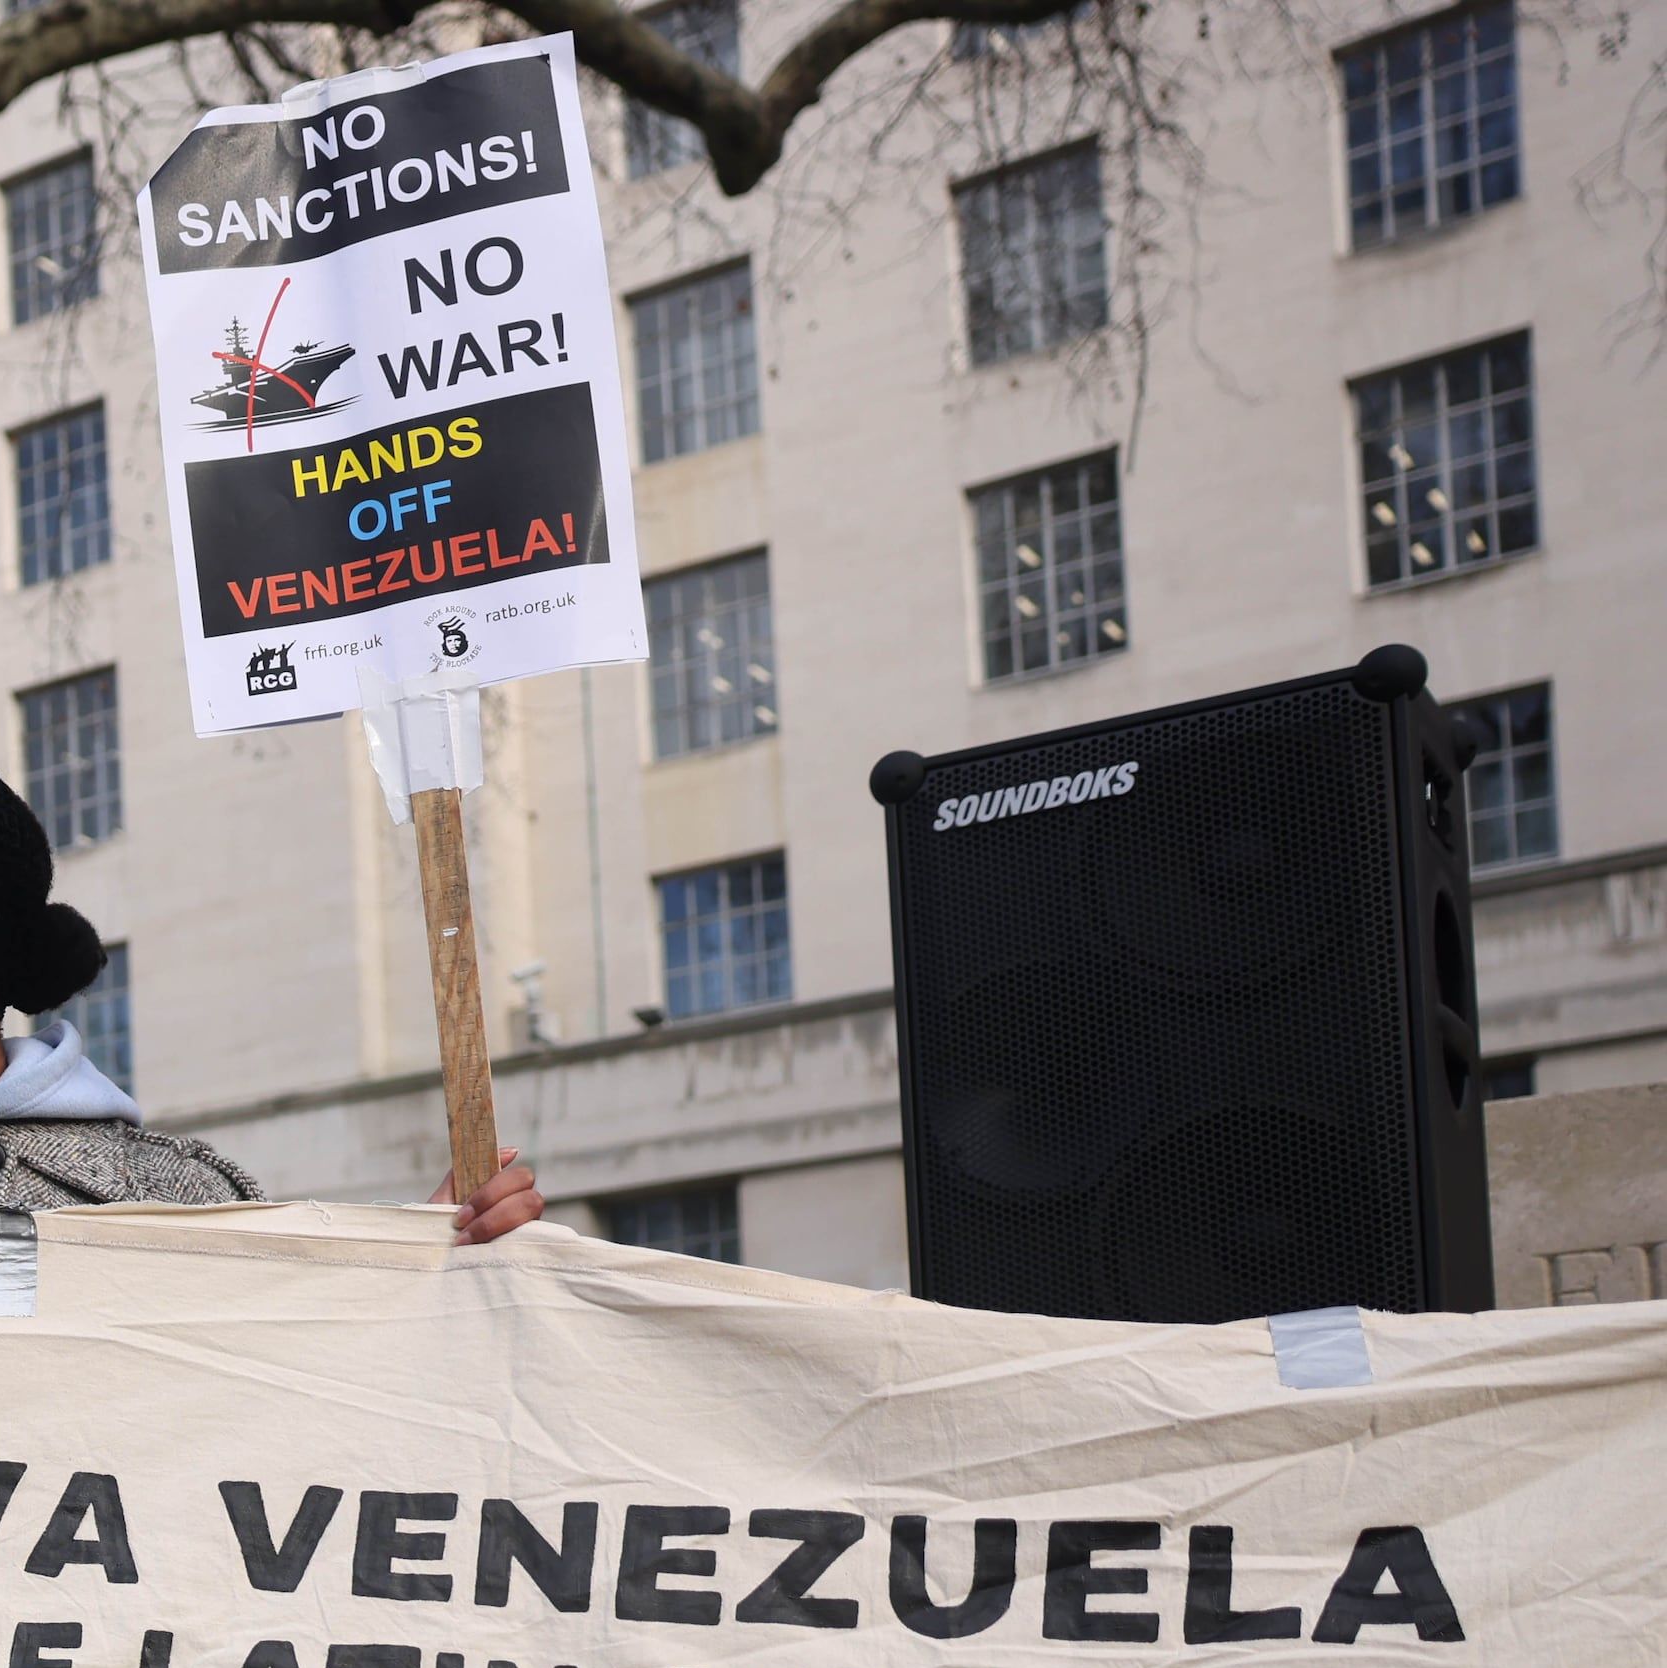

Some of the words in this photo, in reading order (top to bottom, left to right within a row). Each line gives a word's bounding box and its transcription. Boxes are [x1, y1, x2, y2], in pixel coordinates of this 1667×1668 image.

[301, 104, 386, 170] NO
[177, 130, 538, 248] SANCTIONS!
[404, 236, 525, 315] NO
[378, 312, 569, 400] WAR!
[291, 416, 483, 498] HANDS
[347, 479, 452, 541] OFF
[227, 512, 576, 619] VENEZUELA!
[445, 606, 477, 619] AROUND
[485, 592, 576, 624] ratb.org.uk
[304, 634, 383, 661] frfi.org.uk
[446, 644, 483, 668] BLOCKADE
[249, 673, 294, 692] RCG
[933, 760, 1139, 832] SOUNDBOKS
[217, 1480, 1466, 1645] VENEZUELA
